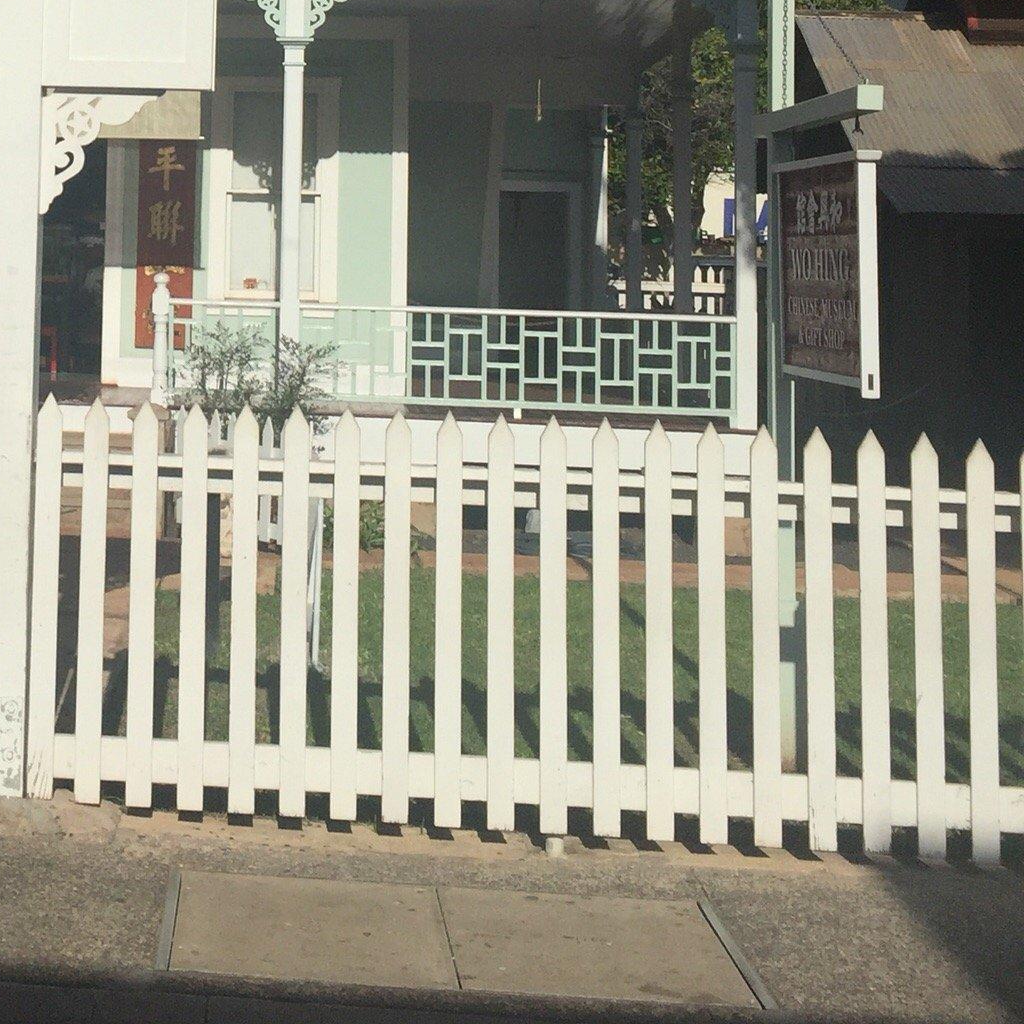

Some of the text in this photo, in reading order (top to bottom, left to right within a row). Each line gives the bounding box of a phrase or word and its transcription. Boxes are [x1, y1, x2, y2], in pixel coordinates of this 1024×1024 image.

[790, 248, 850, 282] WO HING
[788, 296, 857, 322] CHINESE MUSEUM
[805, 327, 822, 346] GIFT
[823, 328, 844, 350] SHOP
